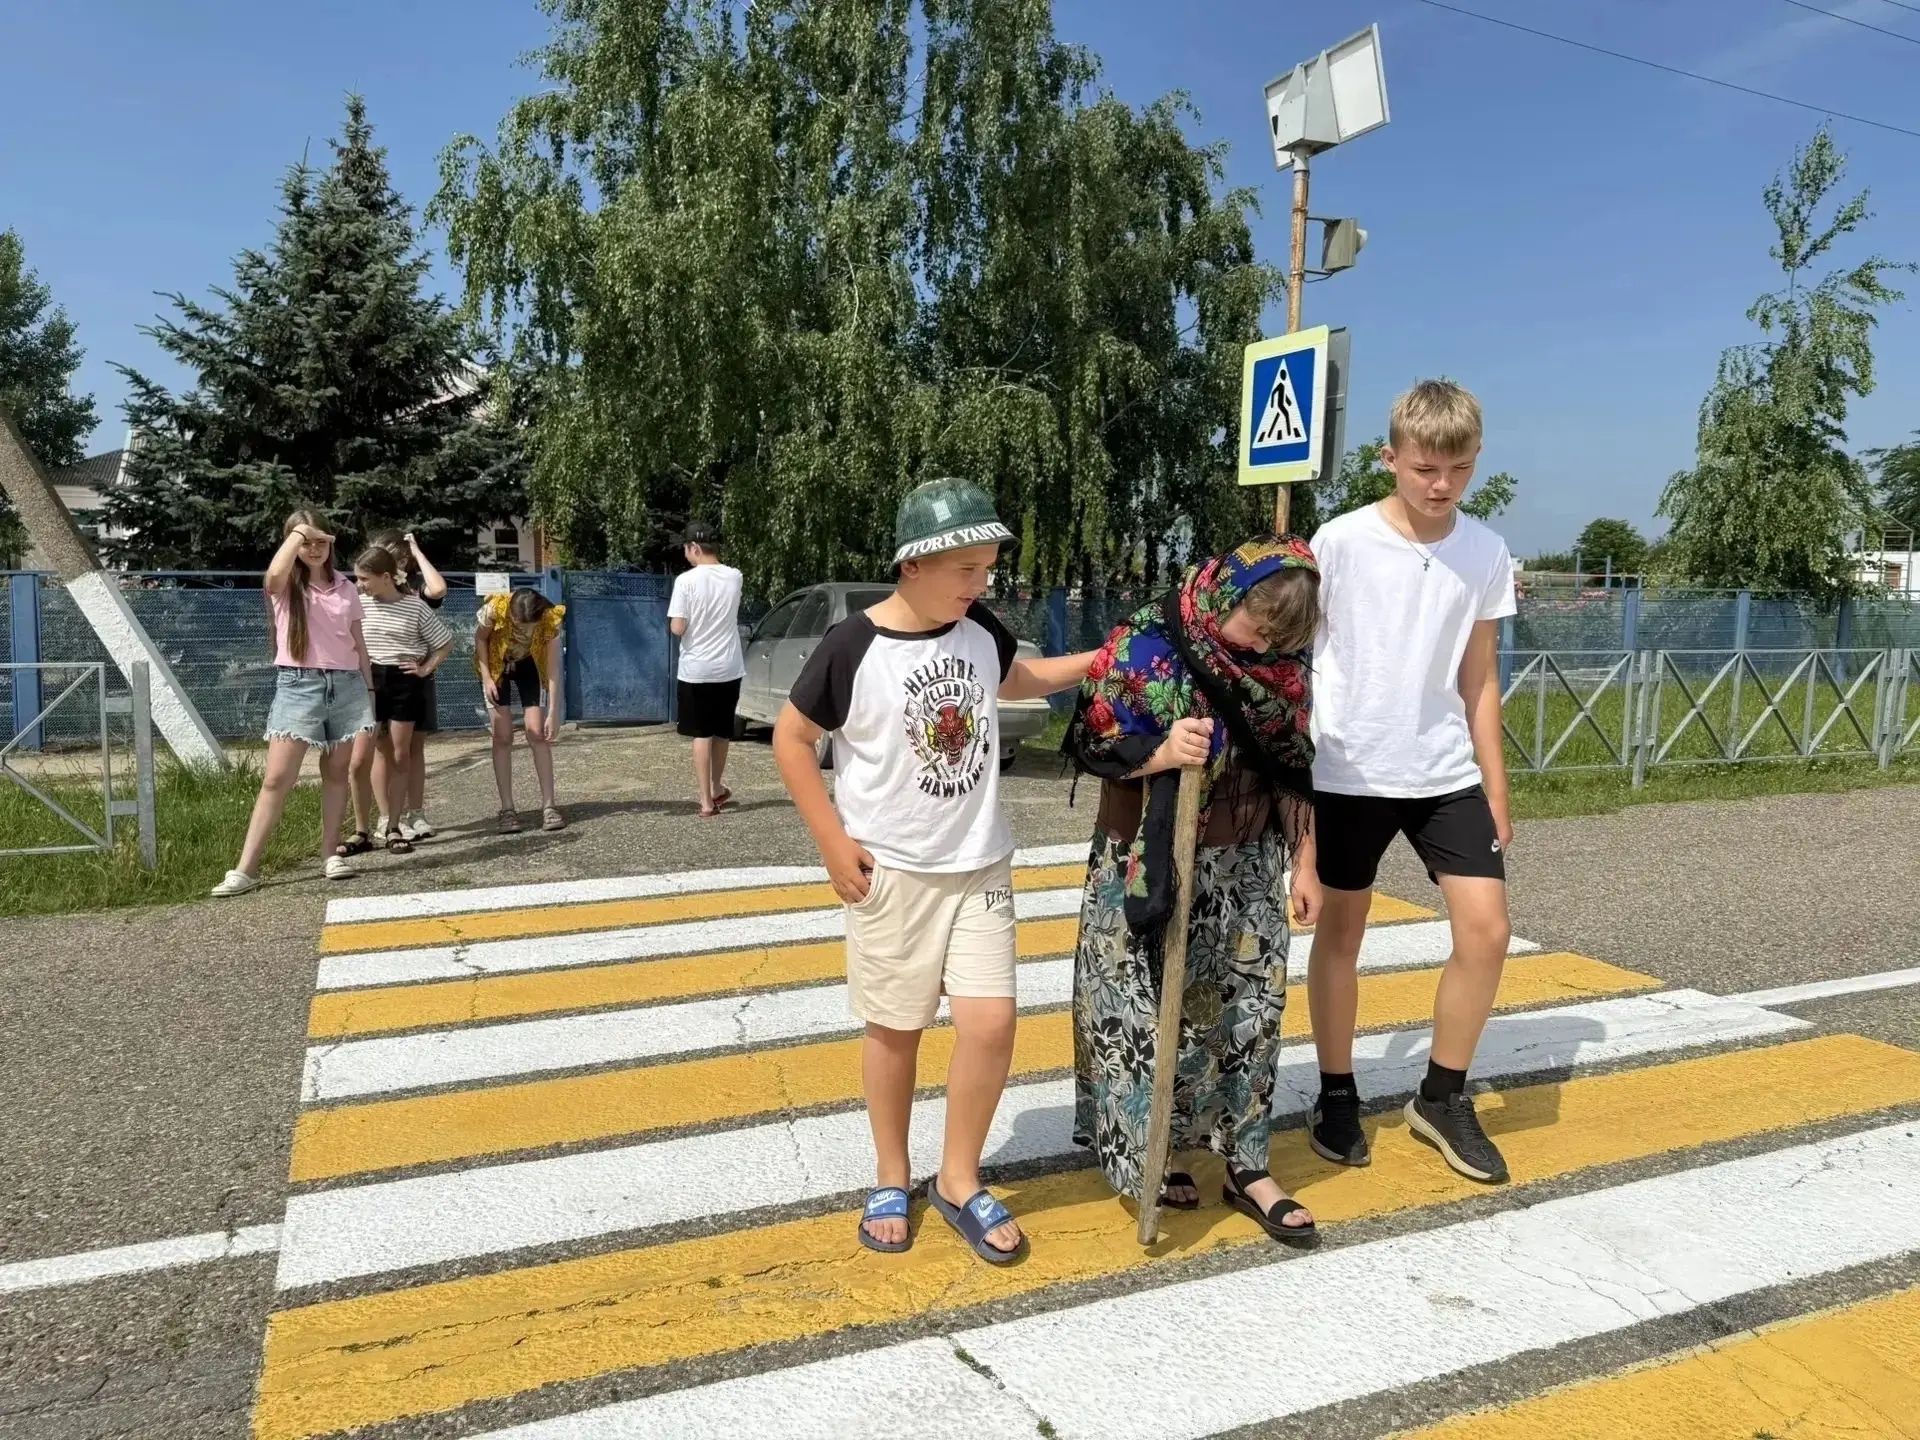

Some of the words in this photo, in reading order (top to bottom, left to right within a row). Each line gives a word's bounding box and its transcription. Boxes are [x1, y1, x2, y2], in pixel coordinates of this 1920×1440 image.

[909, 531, 959, 557] YORK
[903, 655, 976, 697] HELLFIRE
[929, 683, 961, 702] CLUB
[874, 1191, 897, 1202] NIKE
